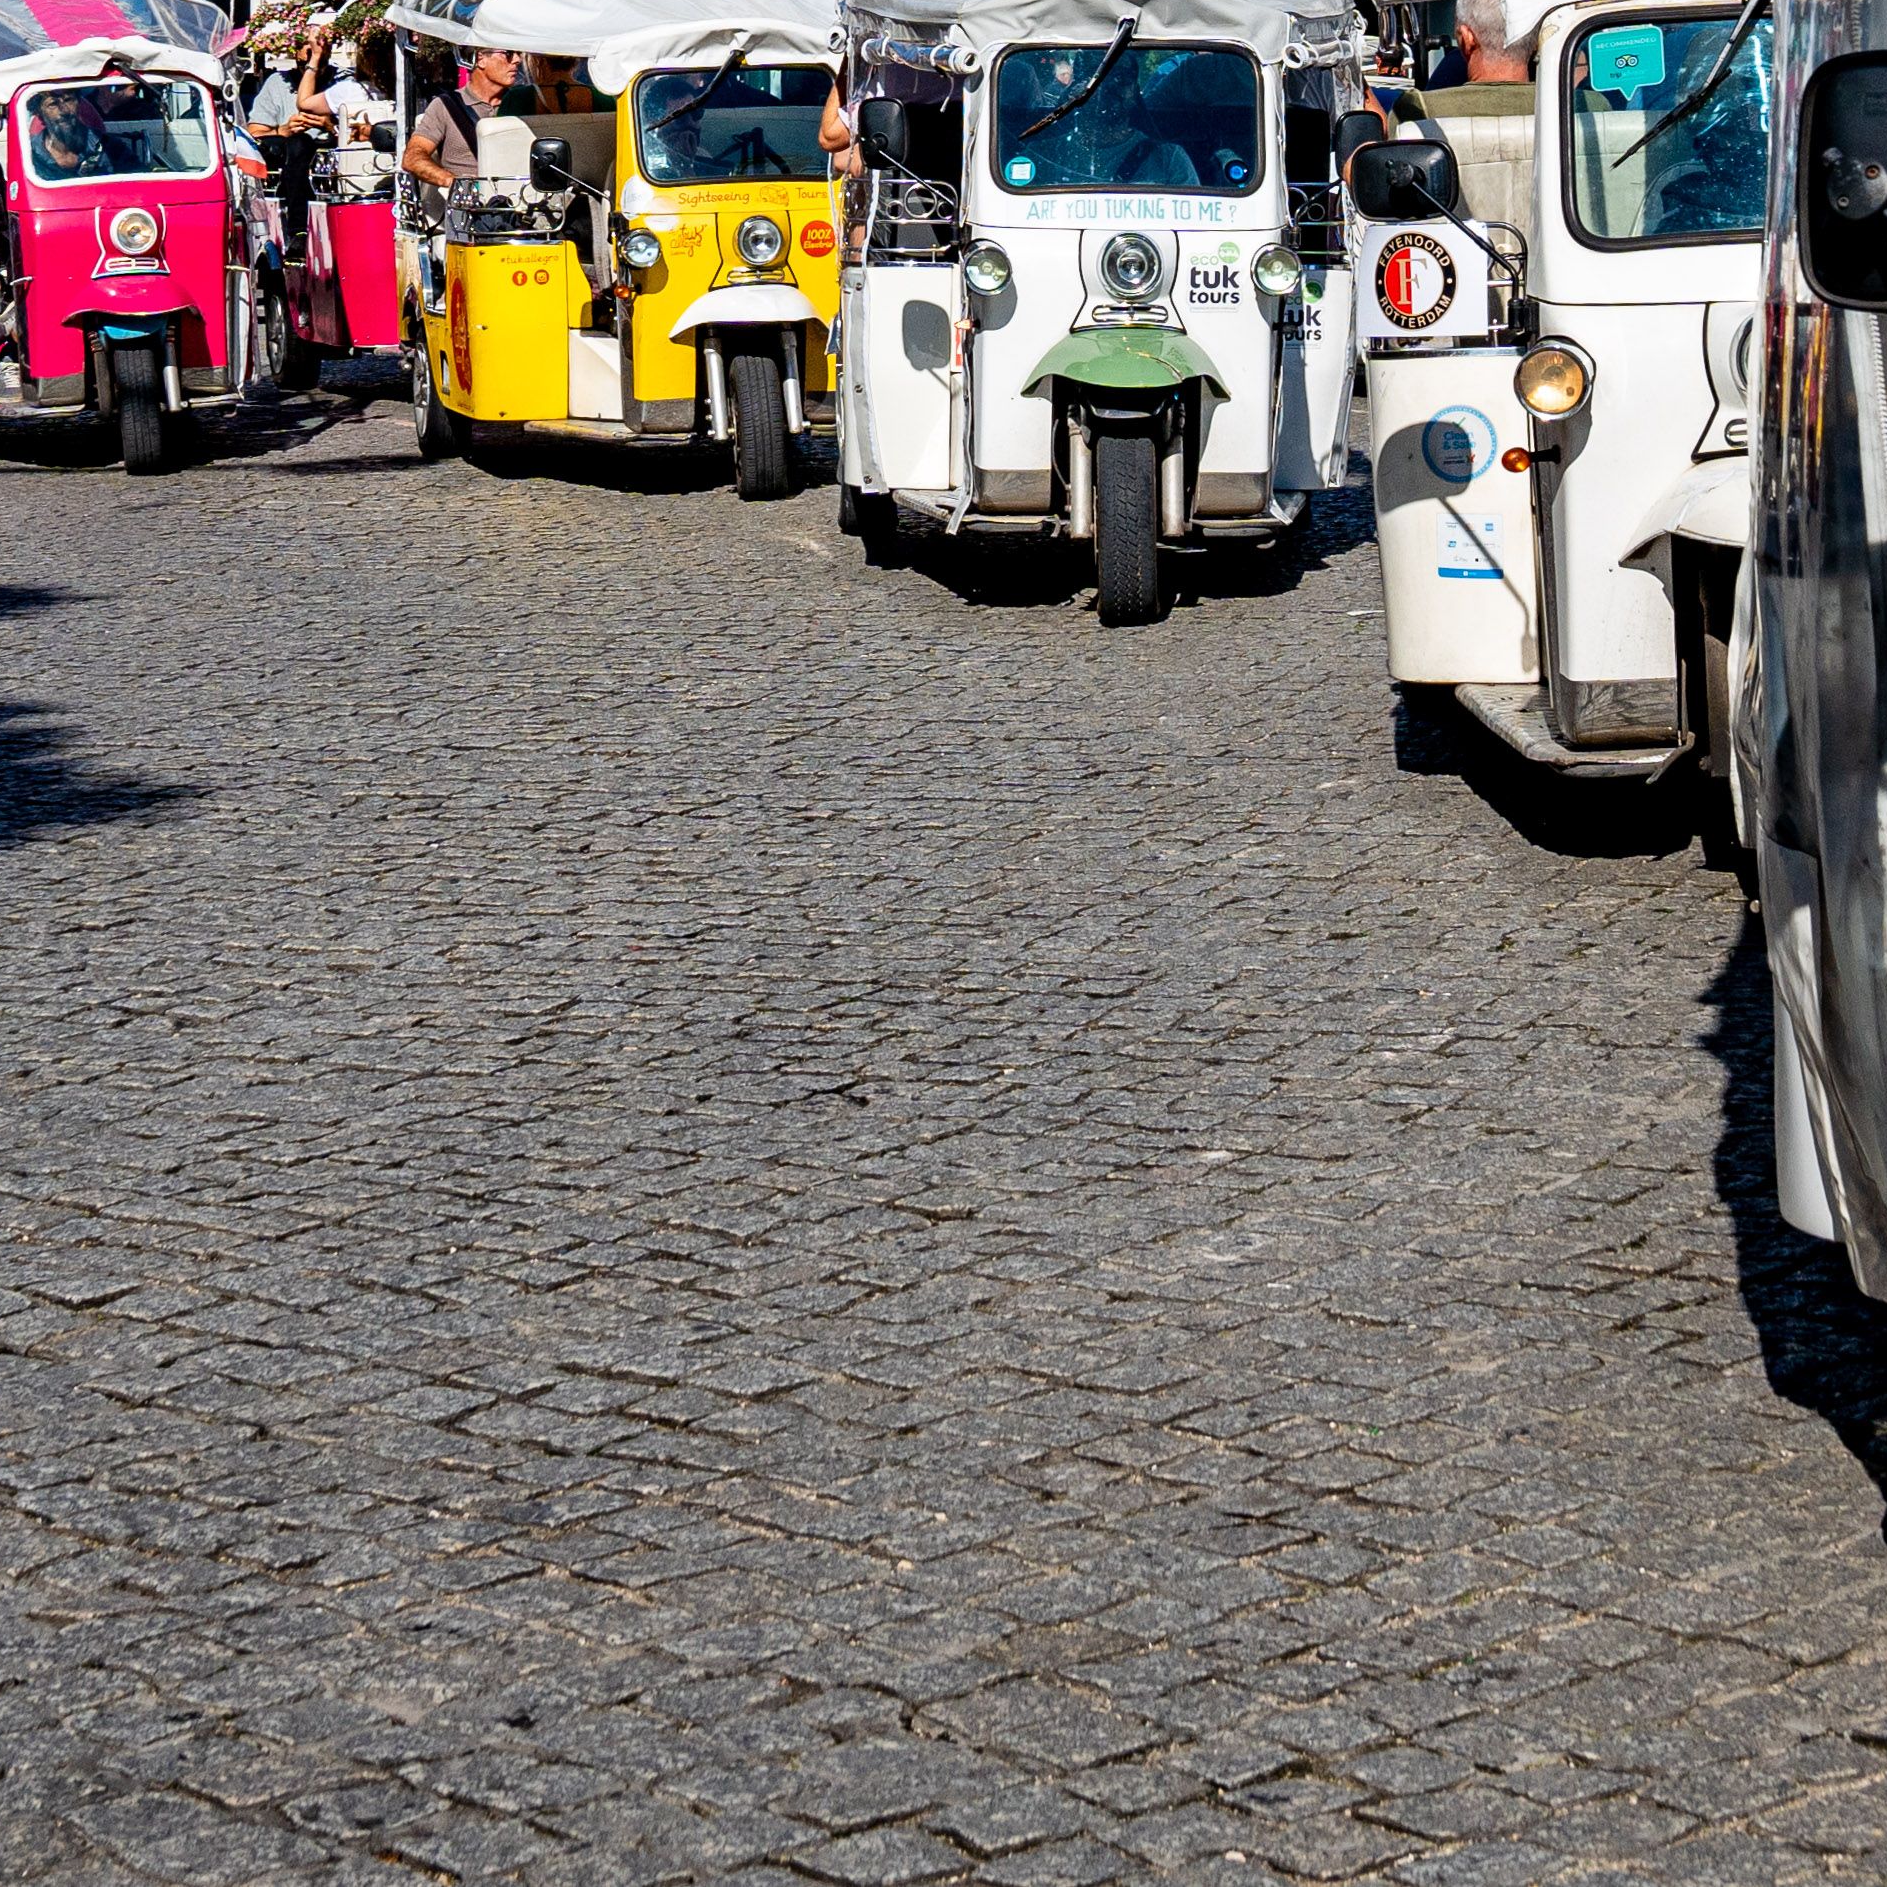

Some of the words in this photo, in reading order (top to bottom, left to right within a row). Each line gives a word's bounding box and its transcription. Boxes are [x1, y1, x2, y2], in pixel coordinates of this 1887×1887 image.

[1595, 37, 1657, 51] RECOMMENDED
[677, 191, 751, 208] Sightseeing
[795, 187, 828, 200] Tours
[1026, 199, 1058, 221] ARE
[1066, 199, 1098, 220] YOU
[1104, 198, 1165, 220] TUKING
[1171, 199, 1192, 221] TO
[1199, 201, 1223, 222] ME
[806, 228, 832, 240] 100%
[1379, 234, 1451, 268] FEYENOORD
[1190, 255, 1219, 266] eco
[1190, 265, 1240, 289] tuk
[1189, 290, 1240, 304] tours
[1380, 295, 1452, 329] ROTTERDAM
[1283, 327, 1322, 342] ours
